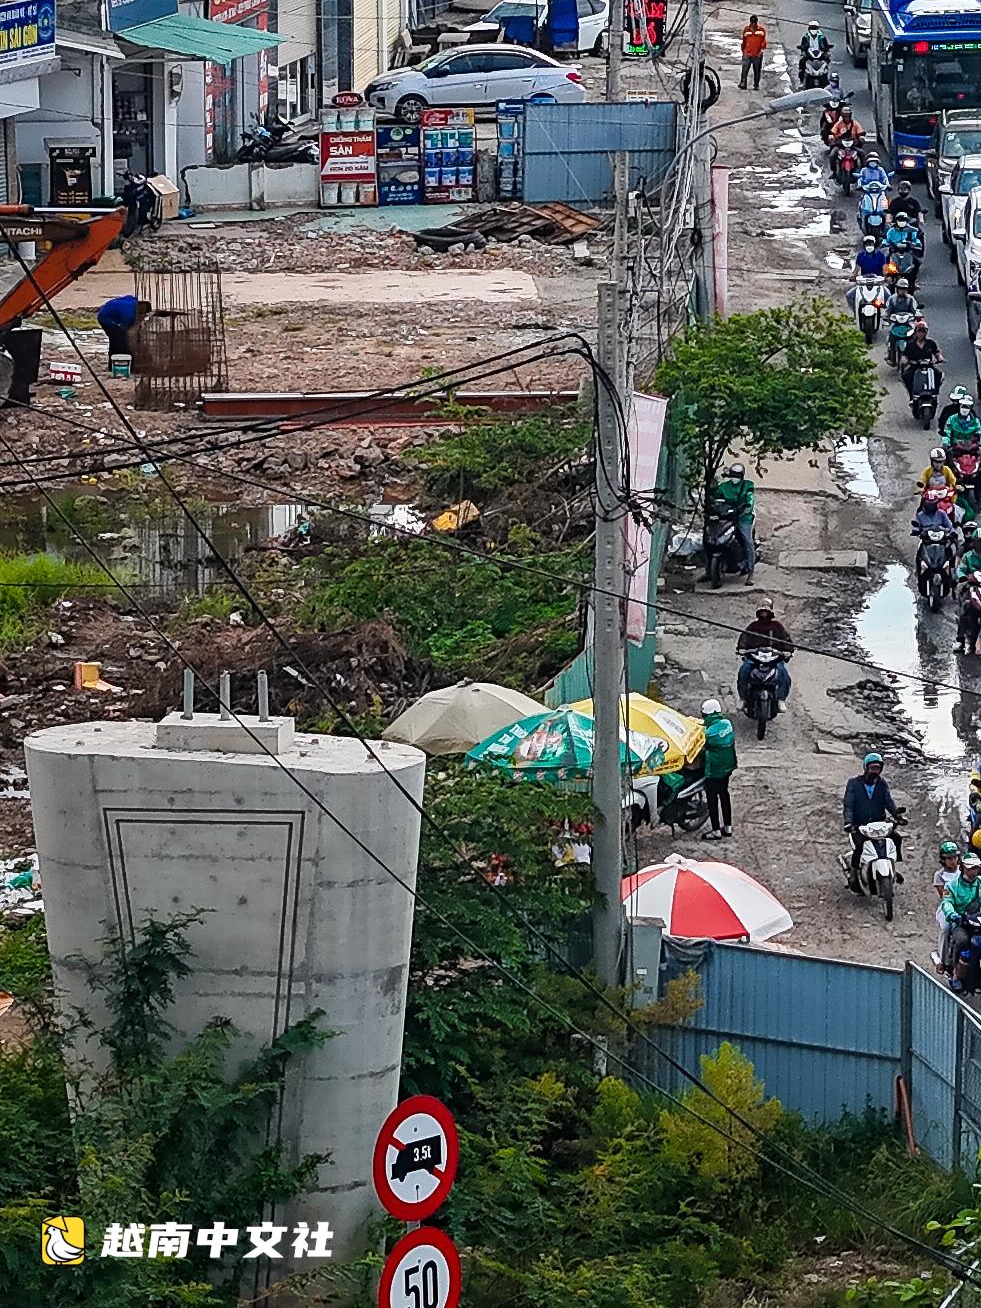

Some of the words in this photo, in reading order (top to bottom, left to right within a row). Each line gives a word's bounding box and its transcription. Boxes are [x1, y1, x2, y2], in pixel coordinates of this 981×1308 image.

[329, 144, 353, 156] SÀN
[413, 1145, 431, 1162] 3.5t
[404, 1260, 438, 1308] 50
